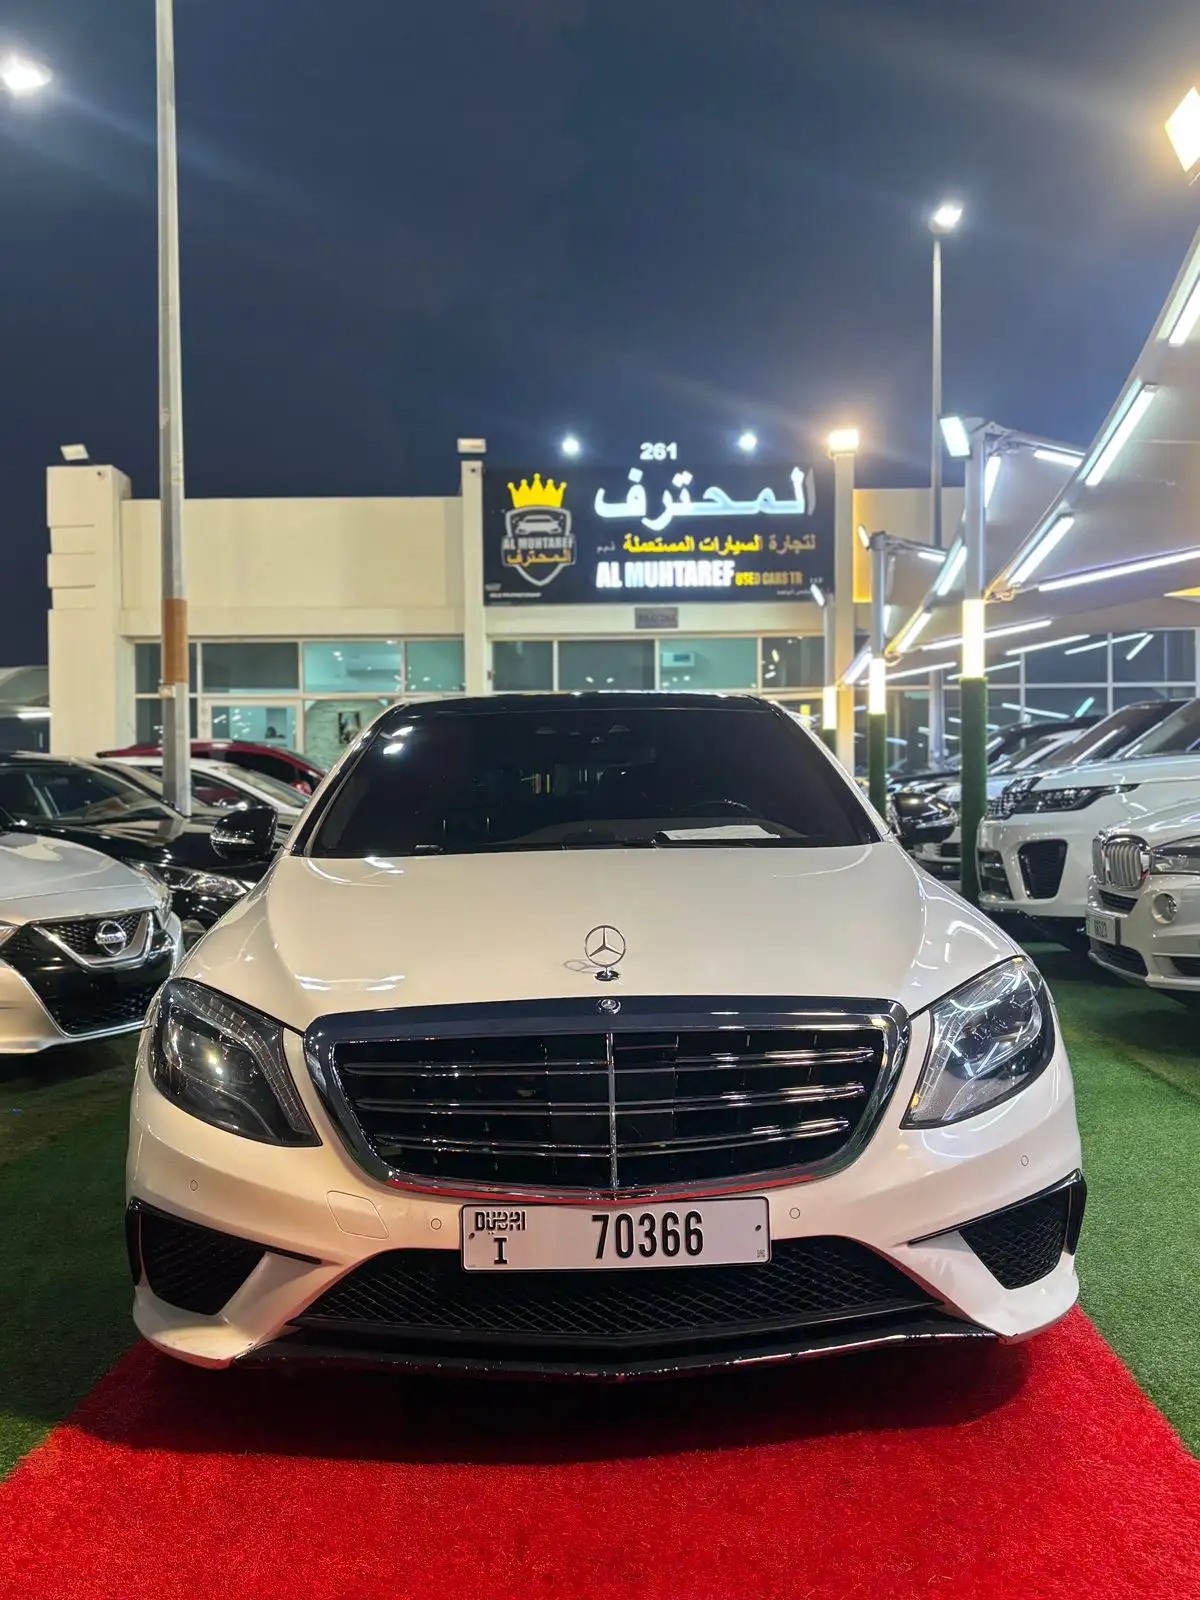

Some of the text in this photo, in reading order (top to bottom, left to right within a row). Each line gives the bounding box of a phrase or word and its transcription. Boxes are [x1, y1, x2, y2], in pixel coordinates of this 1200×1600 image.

[640, 442, 677, 460] 261
[594, 466, 816, 531] المحترف
[502, 538, 516, 550] AL
[623, 531, 695, 553] المستعملة
[698, 533, 764, 556] السيارات
[596, 561, 623, 588] AL
[624, 559, 735, 588] MUHTAREF
[735, 571, 761, 587] USED
[493, 1210, 704, 1265] I 70366
